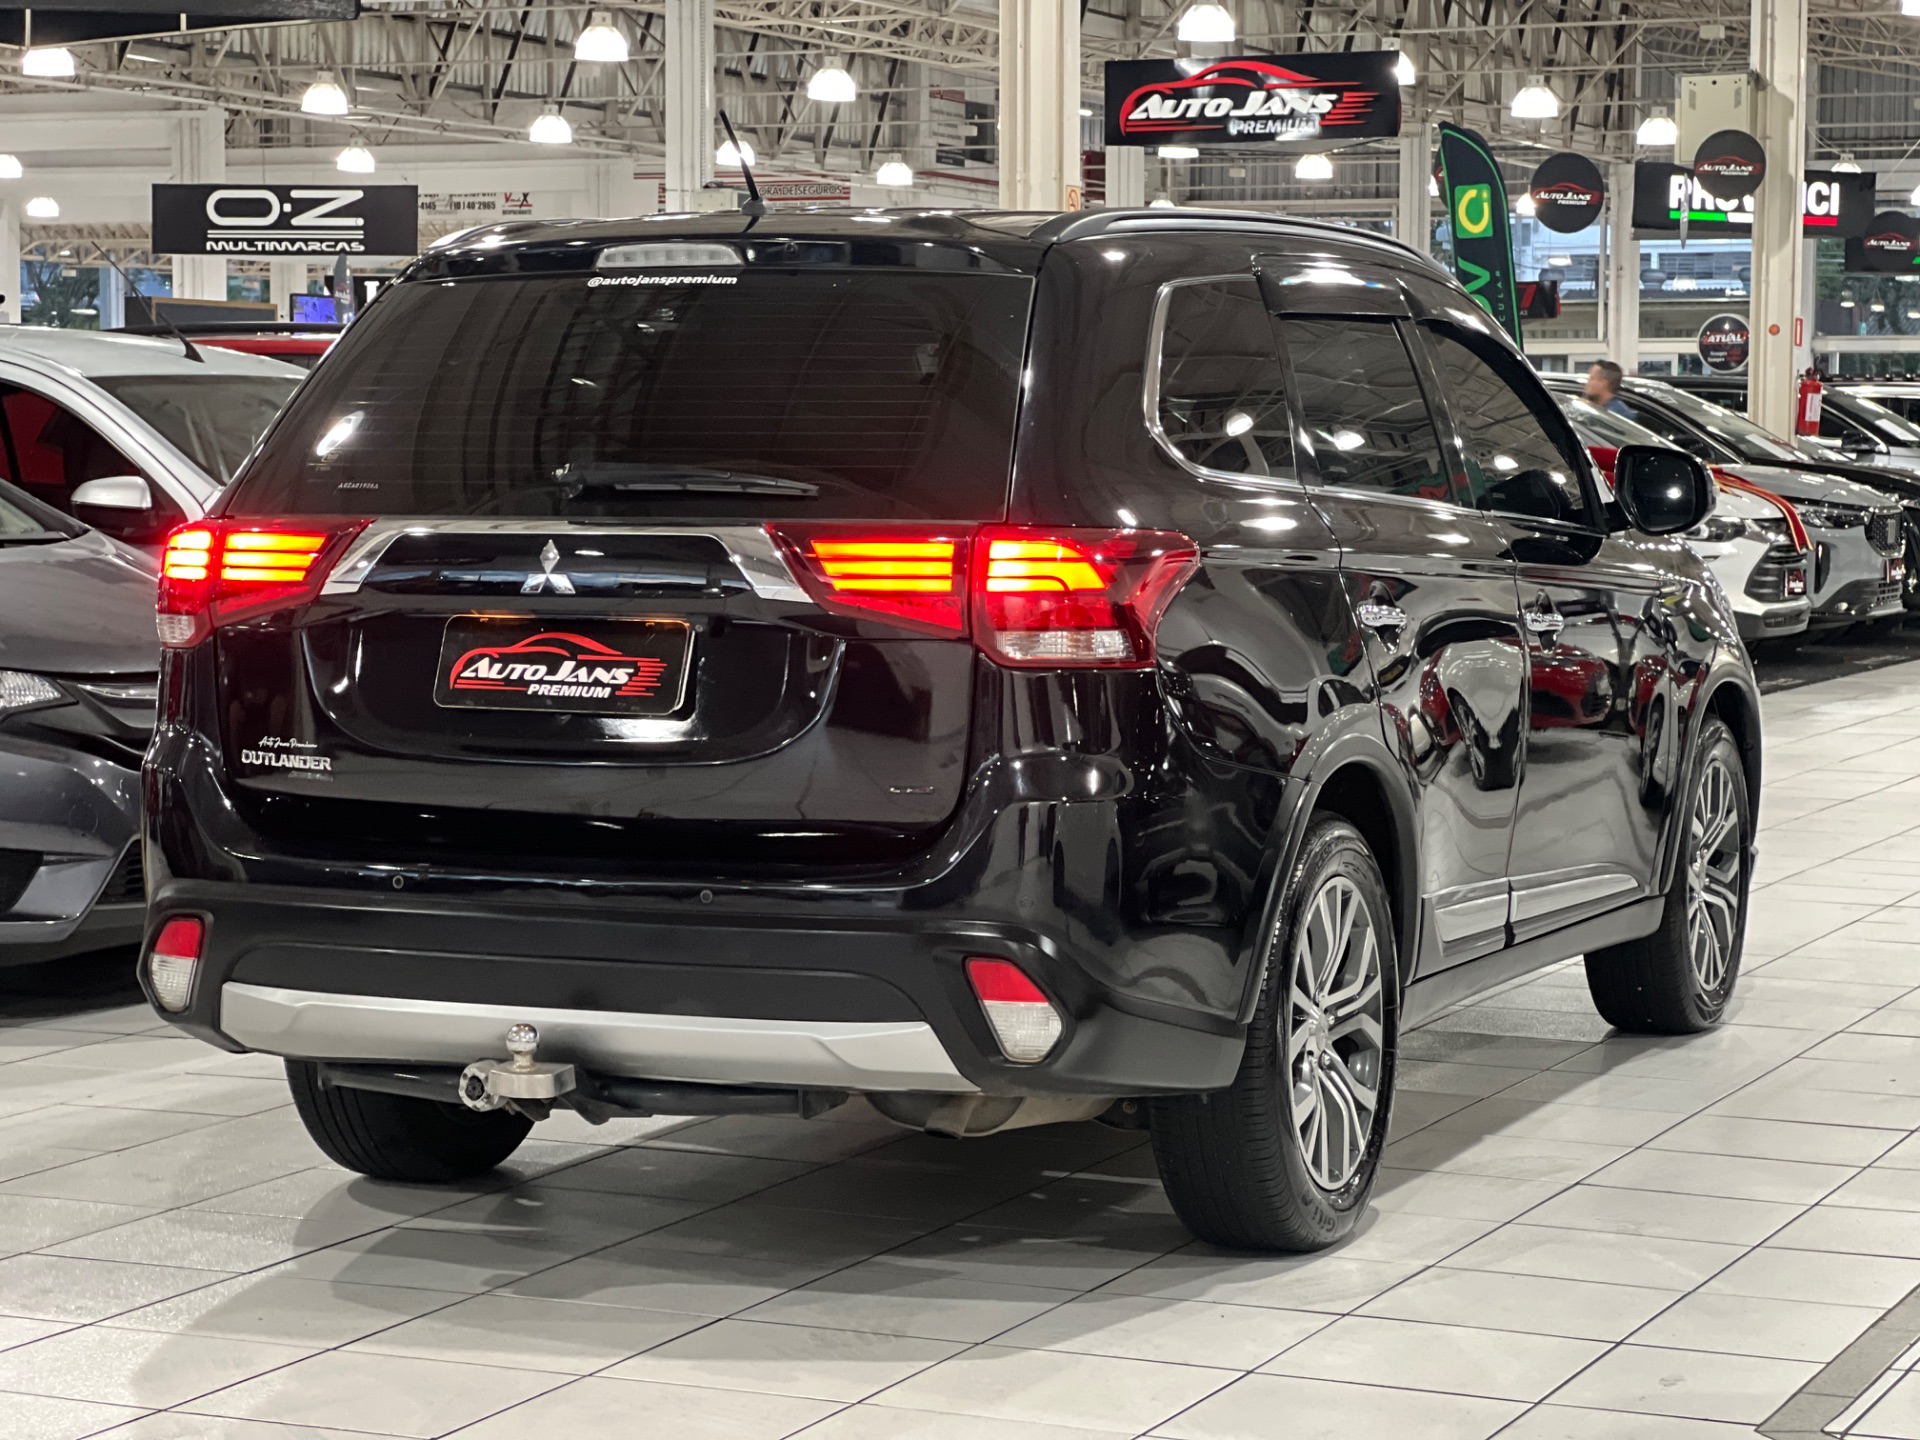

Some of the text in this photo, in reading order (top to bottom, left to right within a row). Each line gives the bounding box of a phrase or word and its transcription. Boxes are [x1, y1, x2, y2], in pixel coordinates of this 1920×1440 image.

[1231, 118, 1318, 135] PREMIUM
[797, 185, 842, 195] SEGUROS
[206, 240, 366, 252] MULTIMARCAS
[587, 275, 738, 287] @autojanspremium
[1495, 270, 1506, 322] CULAR
[527, 684, 612, 699] PREMIUM
[241, 749, 332, 771] OUTLANDER
